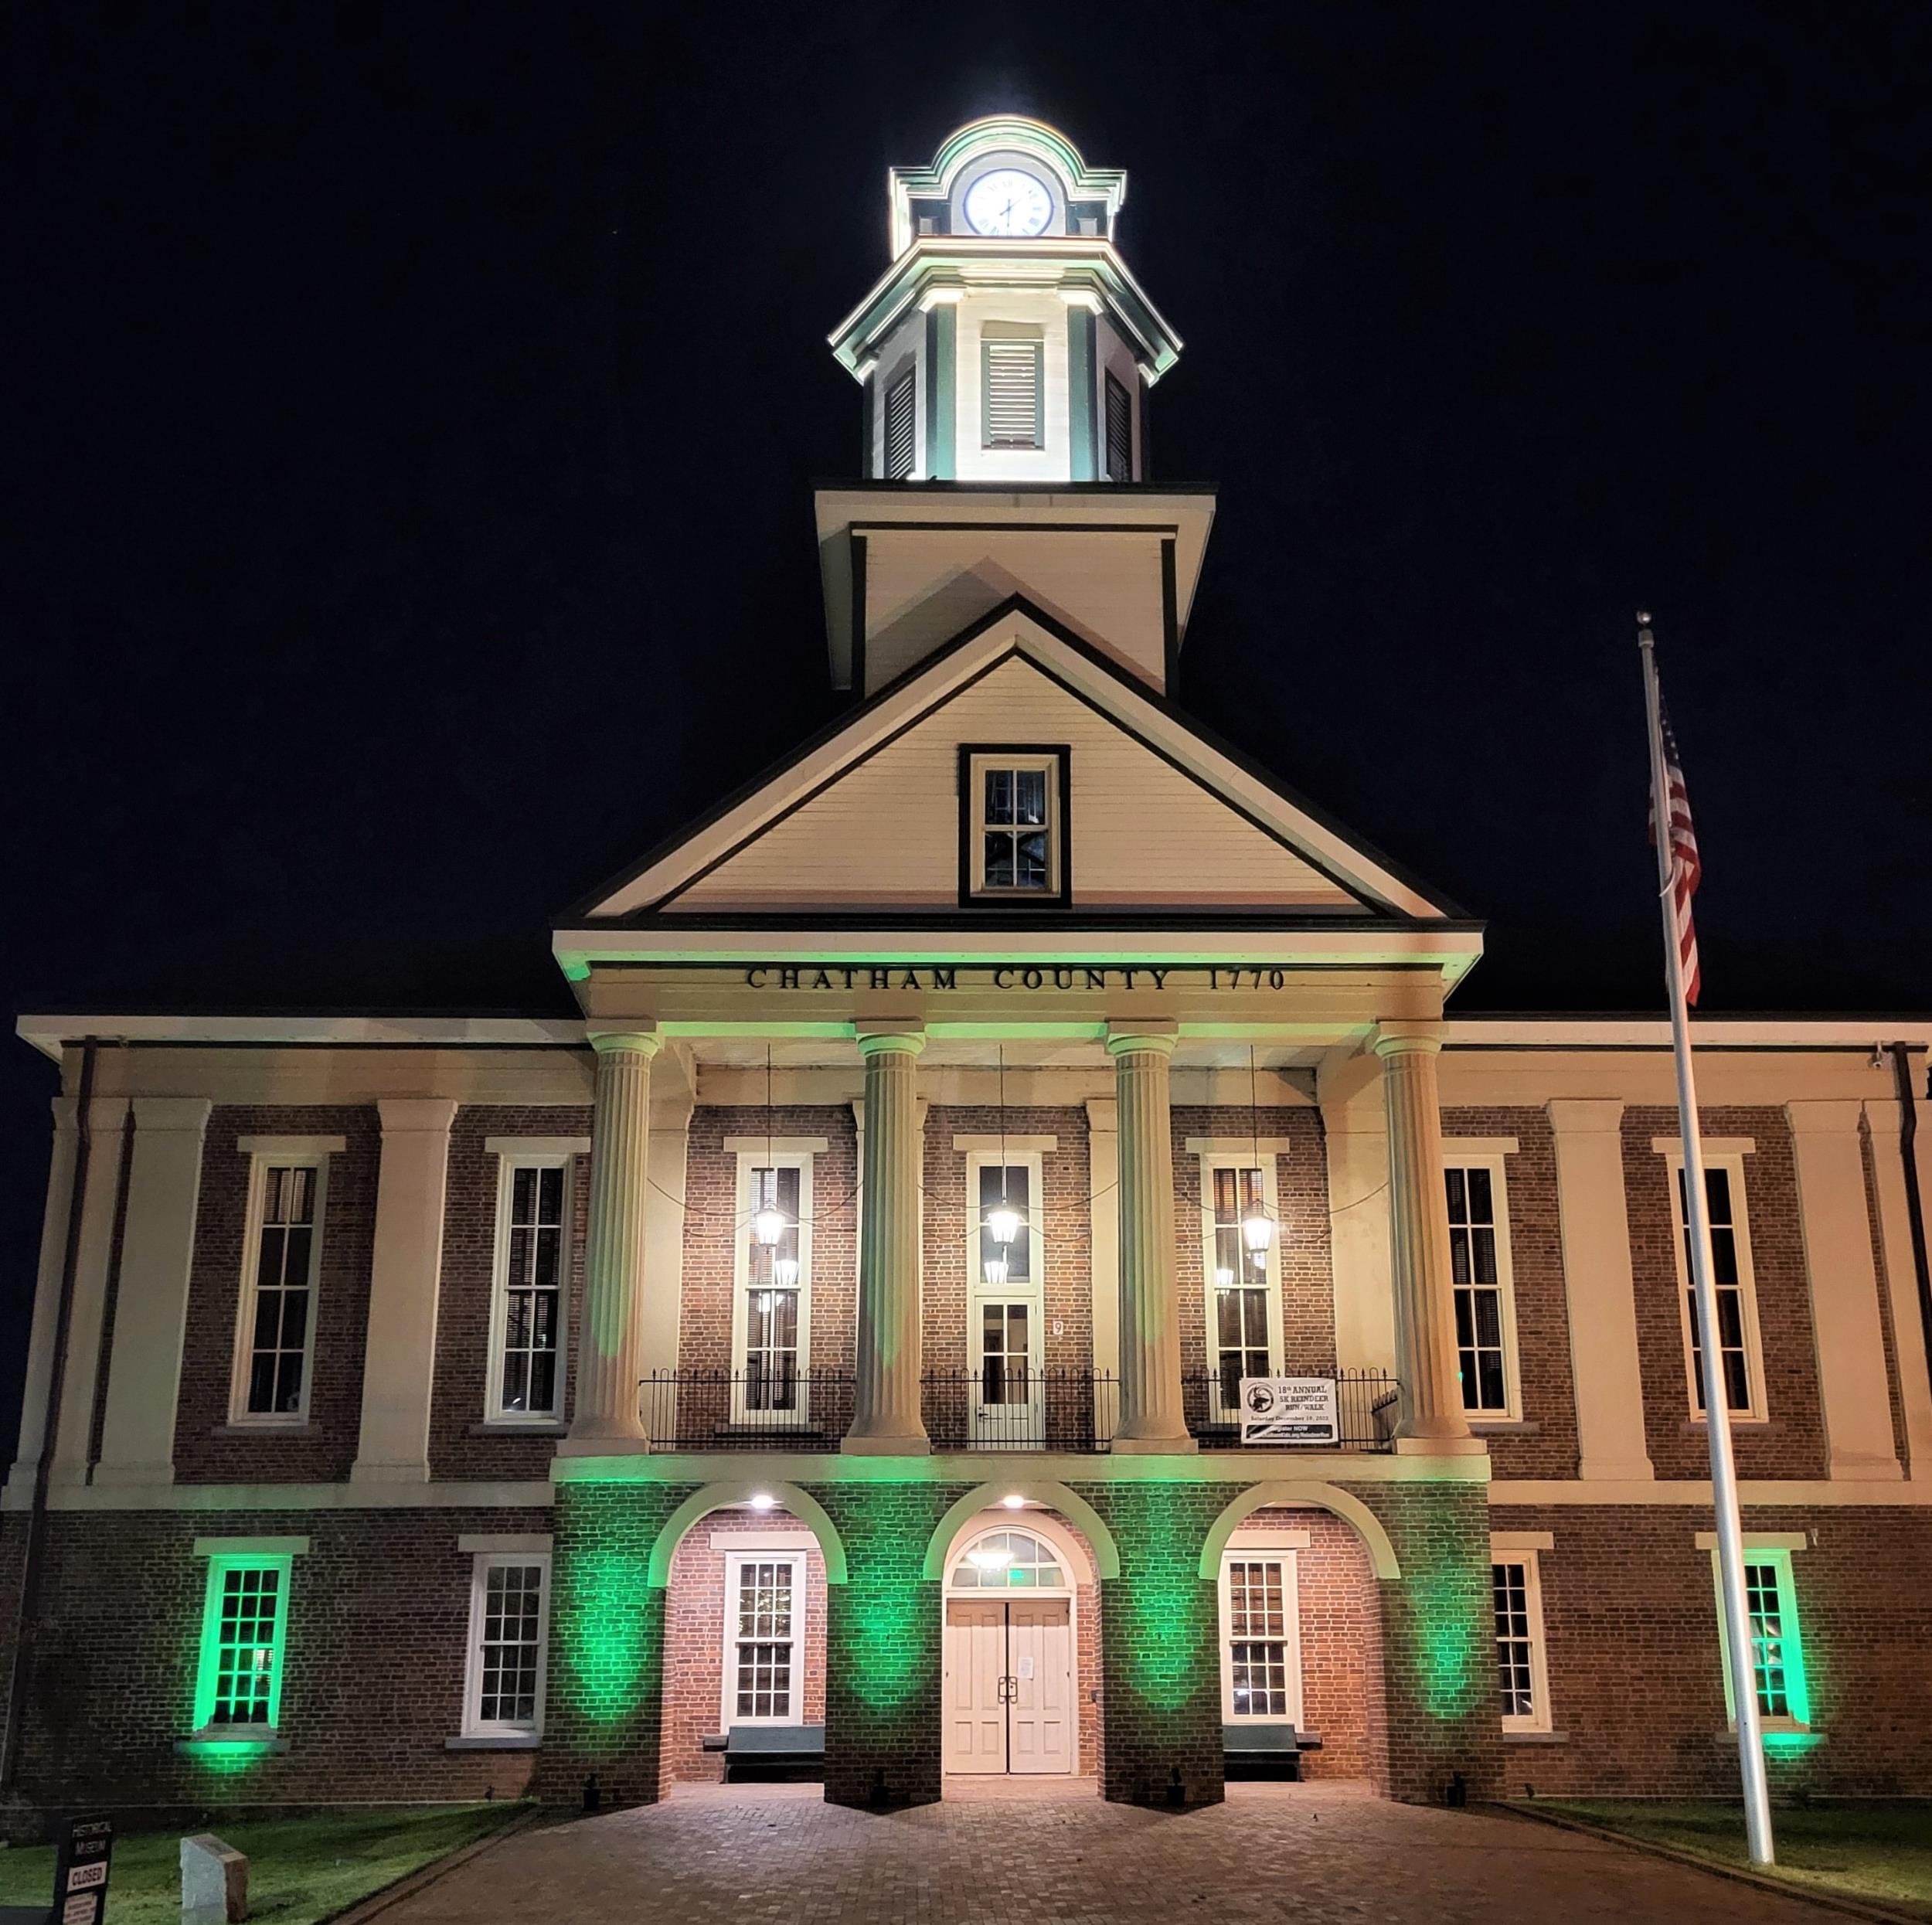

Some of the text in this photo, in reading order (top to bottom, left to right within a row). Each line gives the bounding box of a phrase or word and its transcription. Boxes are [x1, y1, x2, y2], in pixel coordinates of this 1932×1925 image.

[747, 968, 1285, 990] CHATHAM COUNTY 1770
[1055, 1322, 1062, 1334] 9
[1292, 1386, 1327, 1394] ANNUAL
[72, 1866, 103, 1886] CLOSED
